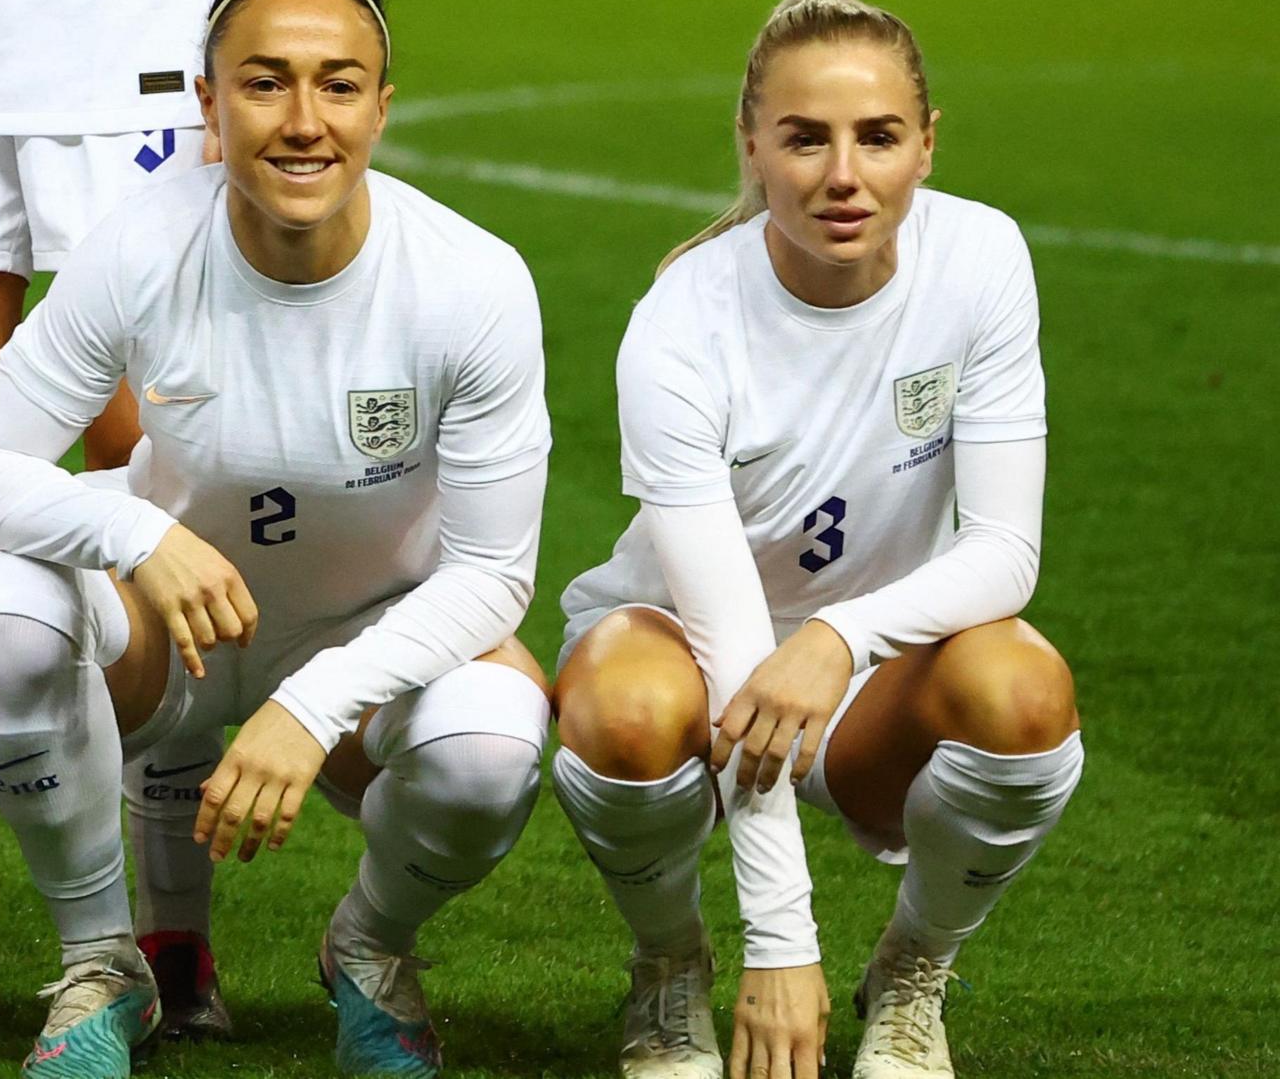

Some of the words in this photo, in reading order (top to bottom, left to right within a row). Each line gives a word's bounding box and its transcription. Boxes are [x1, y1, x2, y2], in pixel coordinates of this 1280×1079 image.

[910, 437, 944, 458] BELGIUM
[365, 461, 404, 476] BELGIUM
[903, 448, 941, 471] FEBRUARY
[357, 471, 402, 487] FEBRUARY
[250, 486, 296, 546] 2
[799, 496, 847, 573] 3
